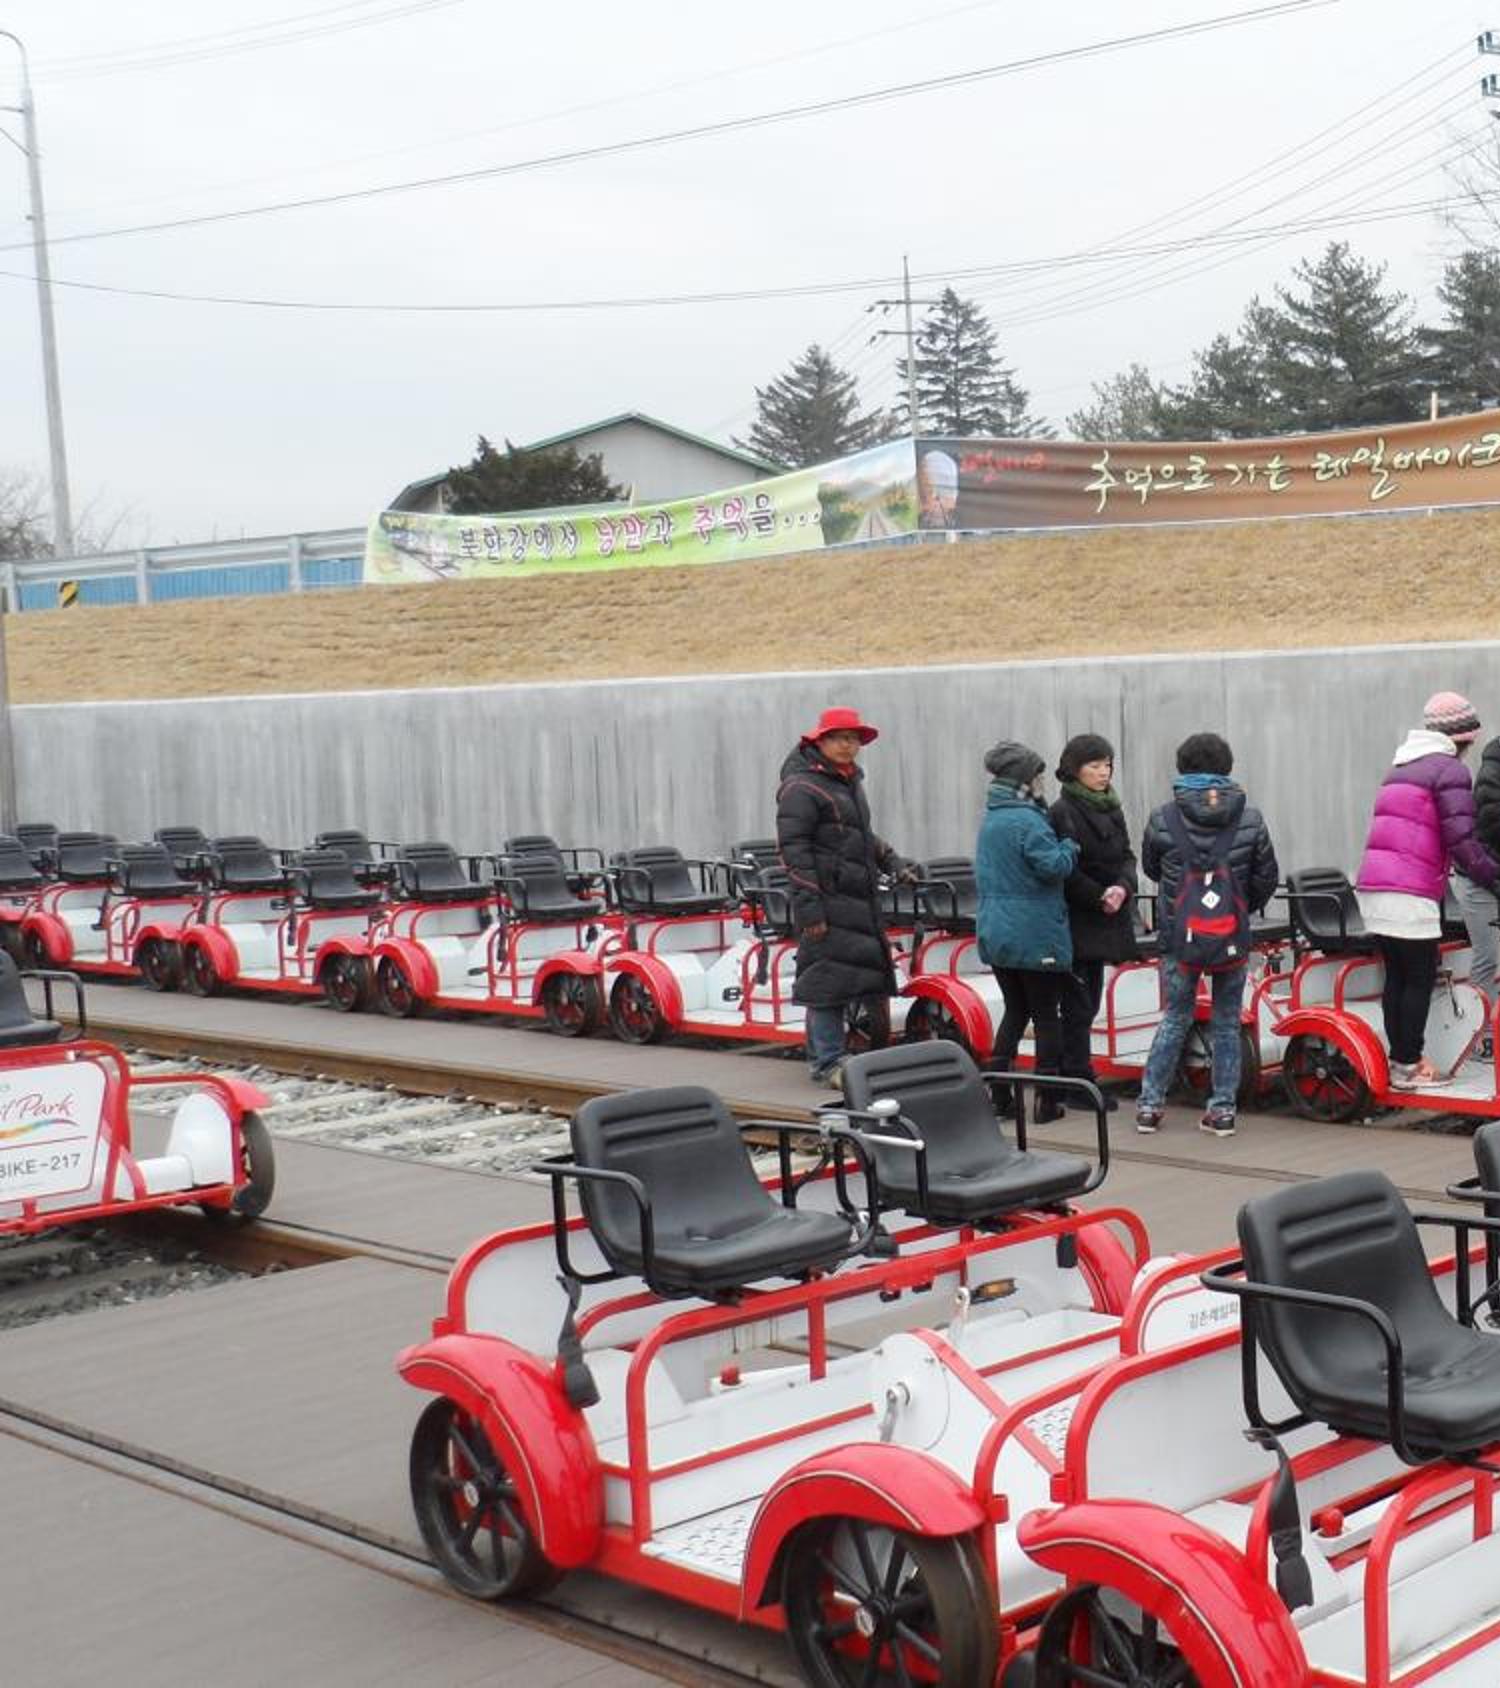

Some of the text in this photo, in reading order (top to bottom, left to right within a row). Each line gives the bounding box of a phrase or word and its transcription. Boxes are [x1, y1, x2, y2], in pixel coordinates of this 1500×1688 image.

[1084, 450, 1215, 514] 추억으로
[1225, 454, 1293, 491] 가는
[460, 519, 579, 564] 북한강에서
[594, 509, 673, 557] 낭만과
[13, 1091, 74, 1118] Park
